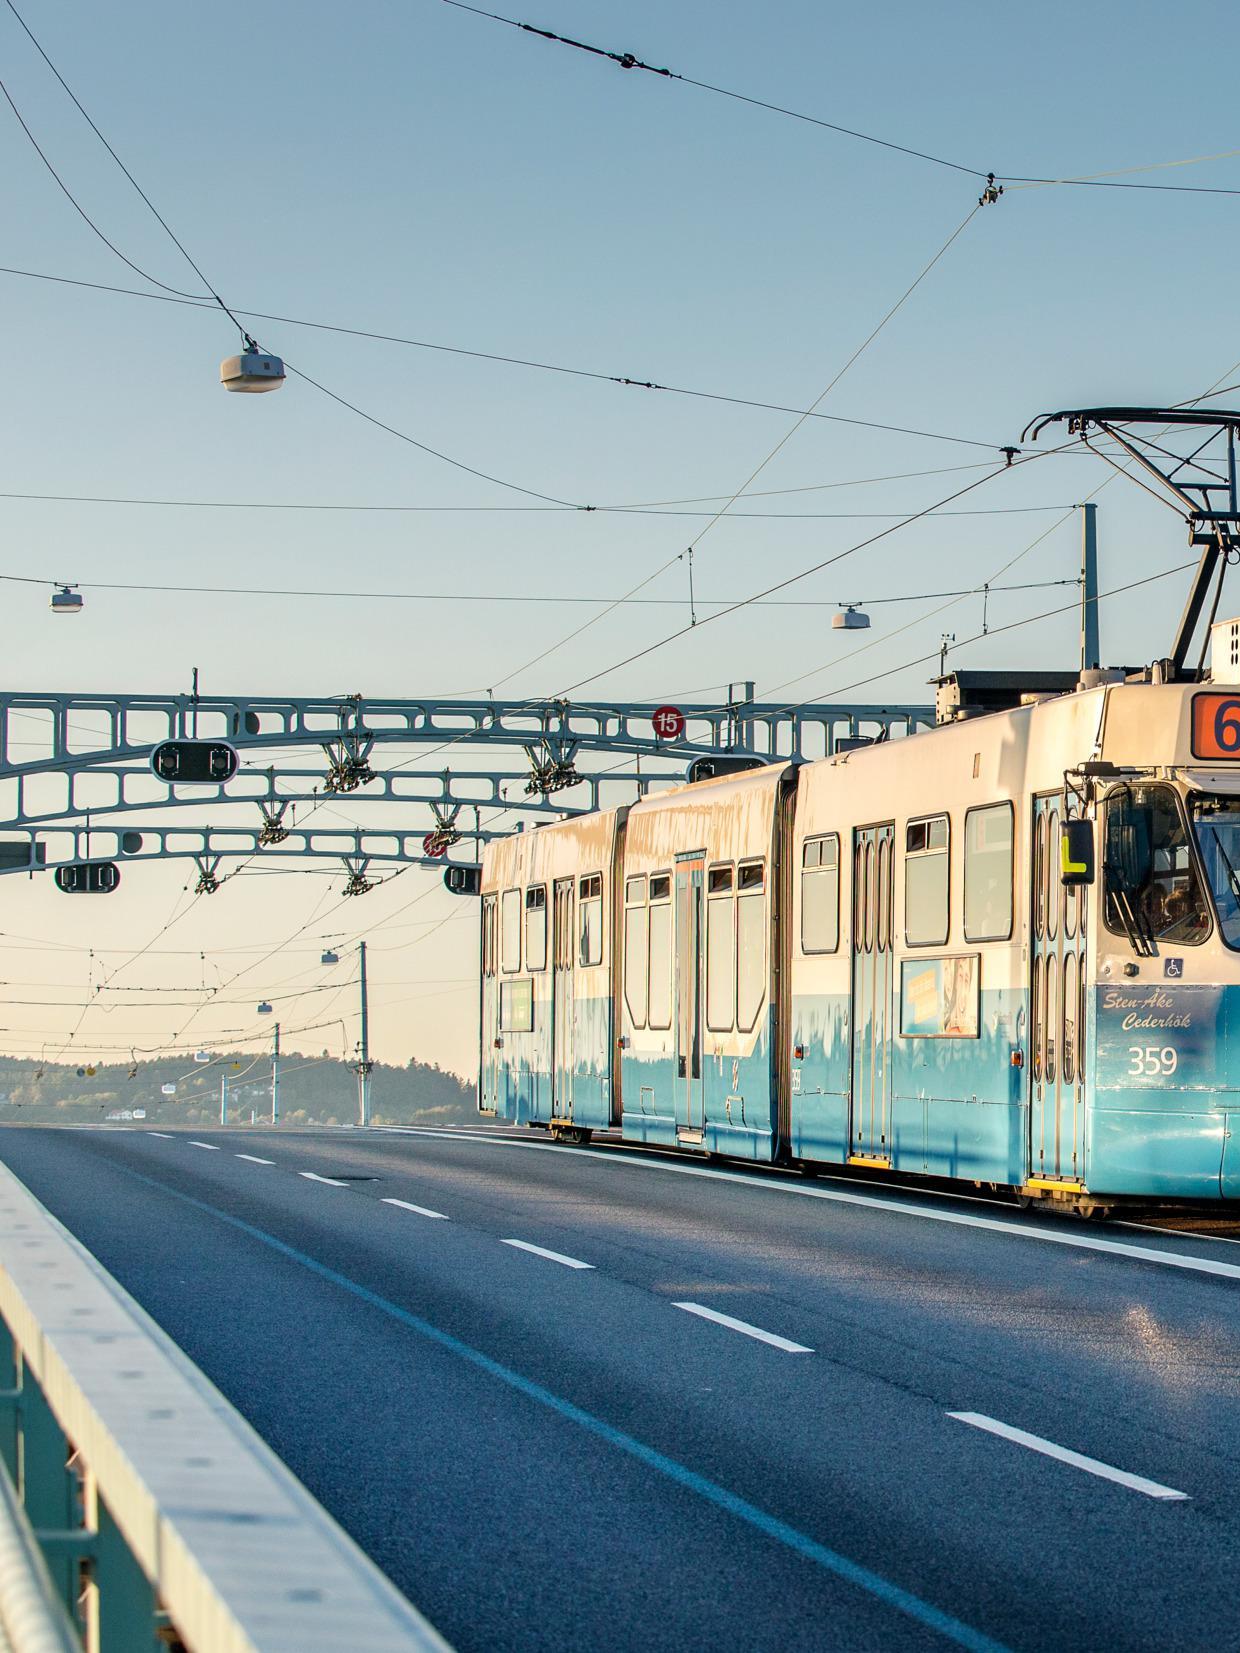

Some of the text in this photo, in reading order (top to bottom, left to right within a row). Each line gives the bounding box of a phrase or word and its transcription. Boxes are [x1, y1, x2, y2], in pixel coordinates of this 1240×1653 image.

[658, 712, 678, 733] 15
[1103, 988, 1174, 1009] Sten-Åke
[1122, 1012, 1192, 1031] Cederhök
[1128, 1046, 1178, 1076] 359
